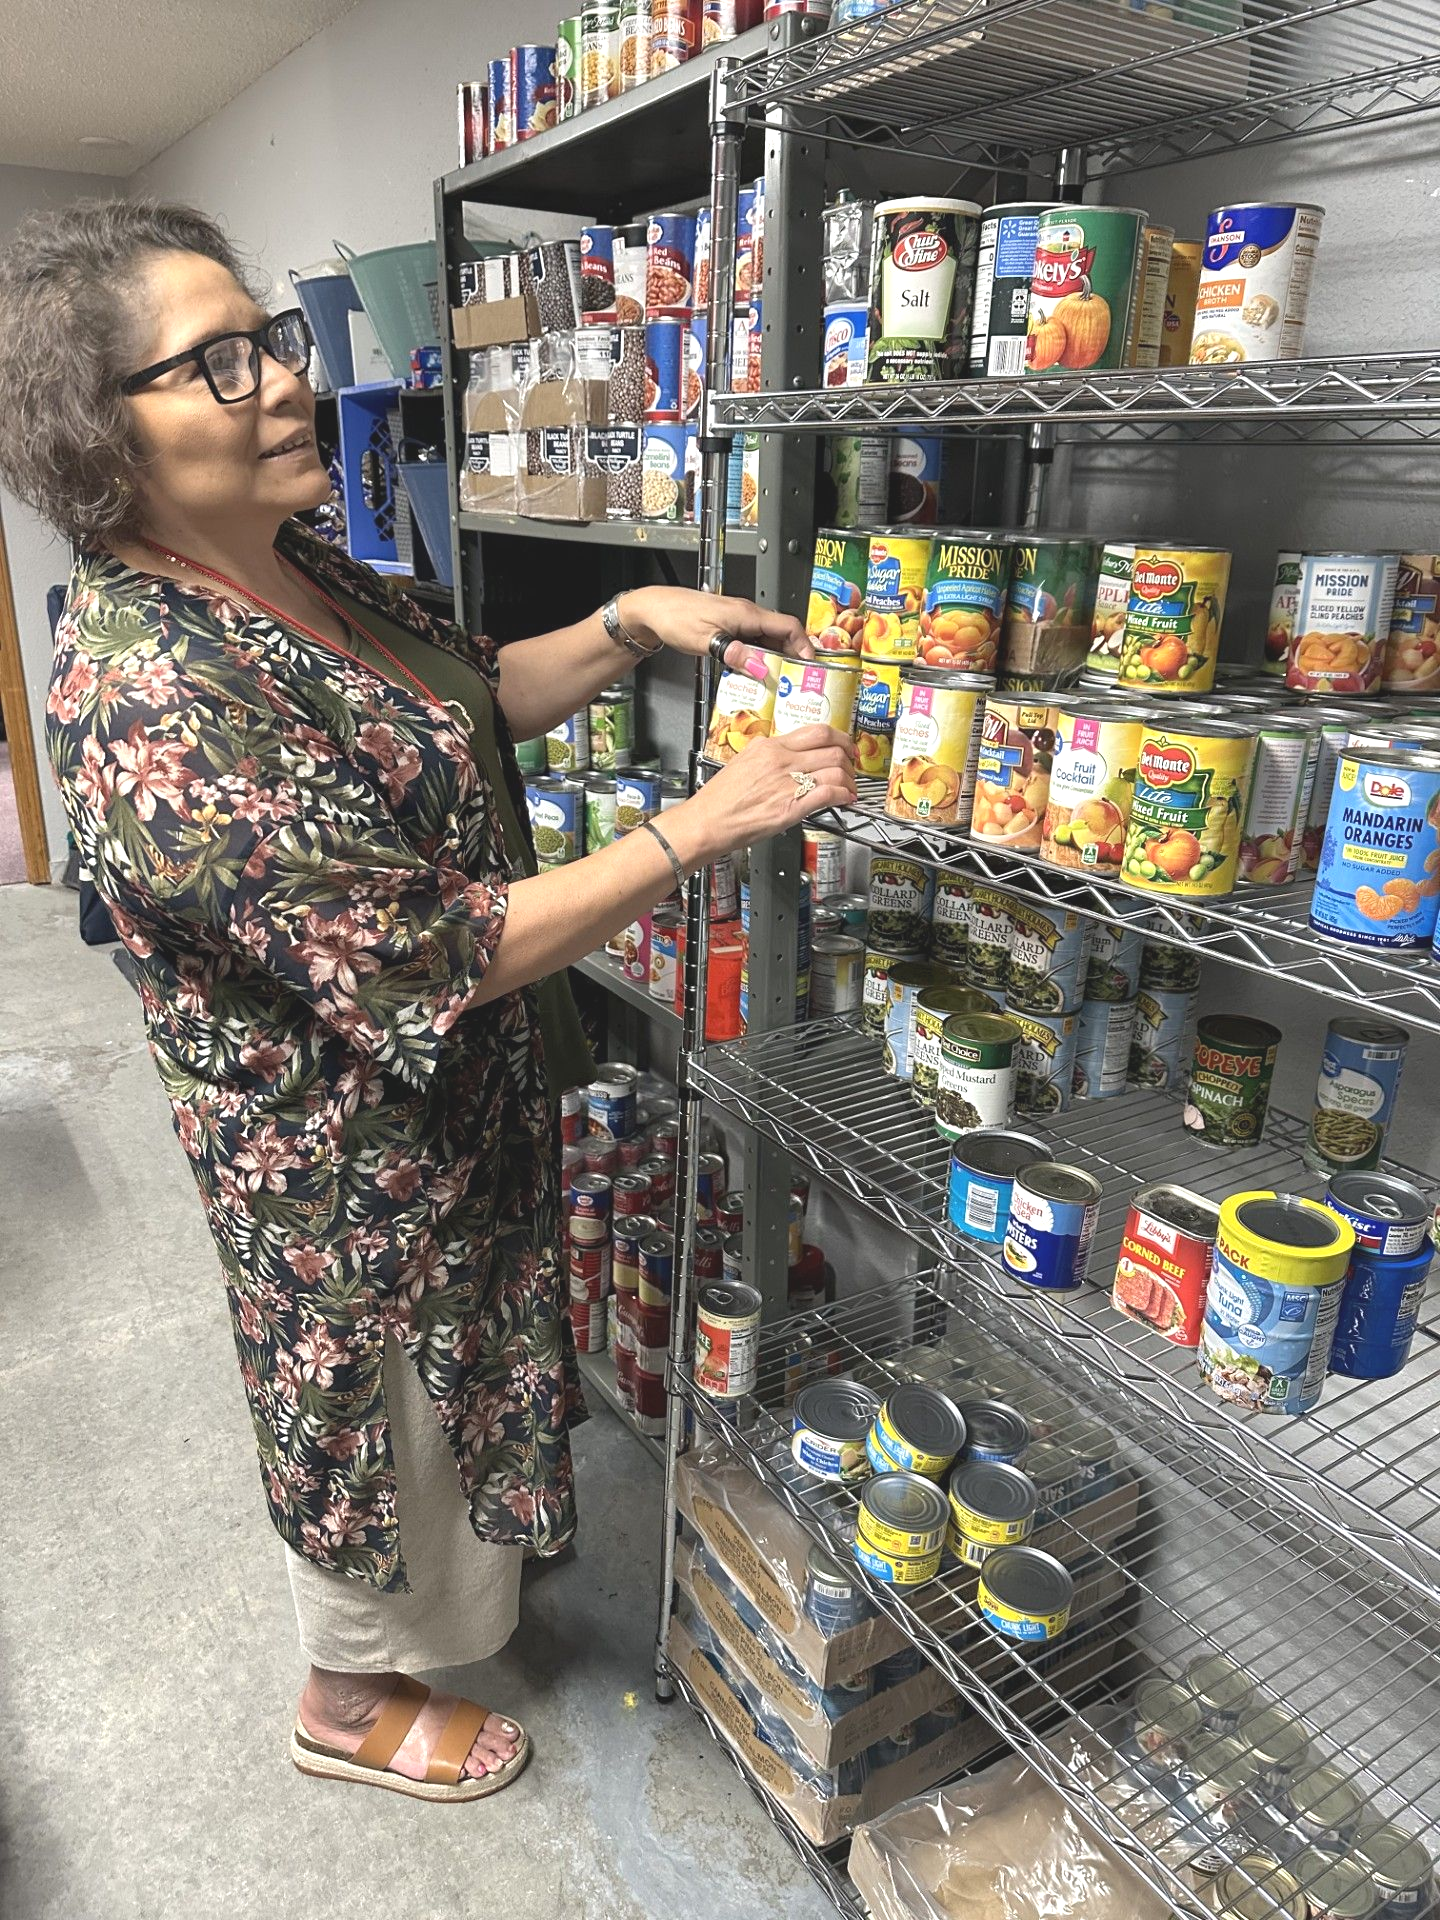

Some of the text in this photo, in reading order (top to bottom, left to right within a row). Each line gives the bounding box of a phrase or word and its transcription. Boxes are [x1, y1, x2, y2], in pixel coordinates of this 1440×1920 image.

[1210, 233, 1242, 244] SWANSON
[901, 289, 930, 308] Salt
[1199, 284, 1241, 299] CHICKEN
[617, 431, 636, 440] TURTLE
[938, 544, 1003, 576] MISSION
[870, 567, 901, 583] Sugar
[948, 565, 991, 580] PRIDE
[1146, 572, 1178, 586] Monte
[1315, 574, 1370, 588] MISSION
[962, 594, 978, 602] LIGHT
[1141, 586, 1161, 596] Quality
[1326, 588, 1353, 597] PRIDE
[872, 595, 901, 606] Peaches
[1311, 604, 1366, 613] SLICED YELLOW
[1127, 614, 1178, 629] Mixed Fruit
[1310, 612, 1365, 621] CLING PEACHES
[726, 680, 758, 695] Peaches
[806, 682, 821, 690] JUICE
[807, 676, 822, 684] FRUIT
[861, 688, 890, 706] Sugar
[915, 696, 929, 704] FRUIT
[785, 700, 822, 715] Peaches
[913, 703, 929, 711] JUICE
[863, 715, 891, 728] Peaches
[1076, 738, 1094, 746] JUICE
[1078, 730, 1095, 739] FRUIT
[1073, 761, 1096, 774] Fruit
[1141, 751, 1191, 773] Del Monte
[1056, 768, 1096, 786] Cocktail
[1147, 770, 1169, 783] Quality
[1139, 788, 1173, 804] Lite
[1370, 780, 1405, 797] Dole
[1156, 809, 1189, 824] Fruit
[1342, 807, 1424, 833] MANDARIN
[1344, 826, 1414, 850] ORANGES
[1353, 848, 1369, 858] 100%
[1370, 850, 1388, 860] FRUIT
[1388, 853, 1405, 862] JUICE
[1353, 863, 1374, 873] SUGAR
[1375, 867, 1401, 876] ADDED
[871, 886, 918, 899] COLLARD
[871, 895, 912, 909] GREENS
[951, 1043, 979, 1059] Choice
[1194, 1036, 1262, 1078] POPEYE
[941, 1075, 968, 1094] Greens
[957, 1070, 997, 1085] Mustard
[1199, 1073, 1239, 1092] CHOPPED
[1192, 1081, 1244, 1107] SPINACH
[1329, 1079, 1376, 1098] Asparagus
[1336, 1090, 1375, 1106] Spears
[1013, 1191, 1043, 1217] Chicken
[1017, 1206, 1031, 1221] Sea
[1012, 1219, 1027, 1233] Whole
[1140, 1218, 1172, 1243] Libby's
[1123, 1236, 1187, 1279] CORNED BEEF
[1219, 1237, 1251, 1270] PACK
[1218, 1291, 1243, 1318] Tuna
[1228, 1291, 1245, 1306] Light
[1286, 1294, 1307, 1303] MSC
[1238, 1328, 1266, 1344] CAUGHT
[804, 1436, 837, 1454] CRIDER
[816, 1456, 839, 1468] Chicken
[872, 1559, 887, 1571] LIGHT
[1000, 1620, 1040, 1632] CHUNK LIGHT
